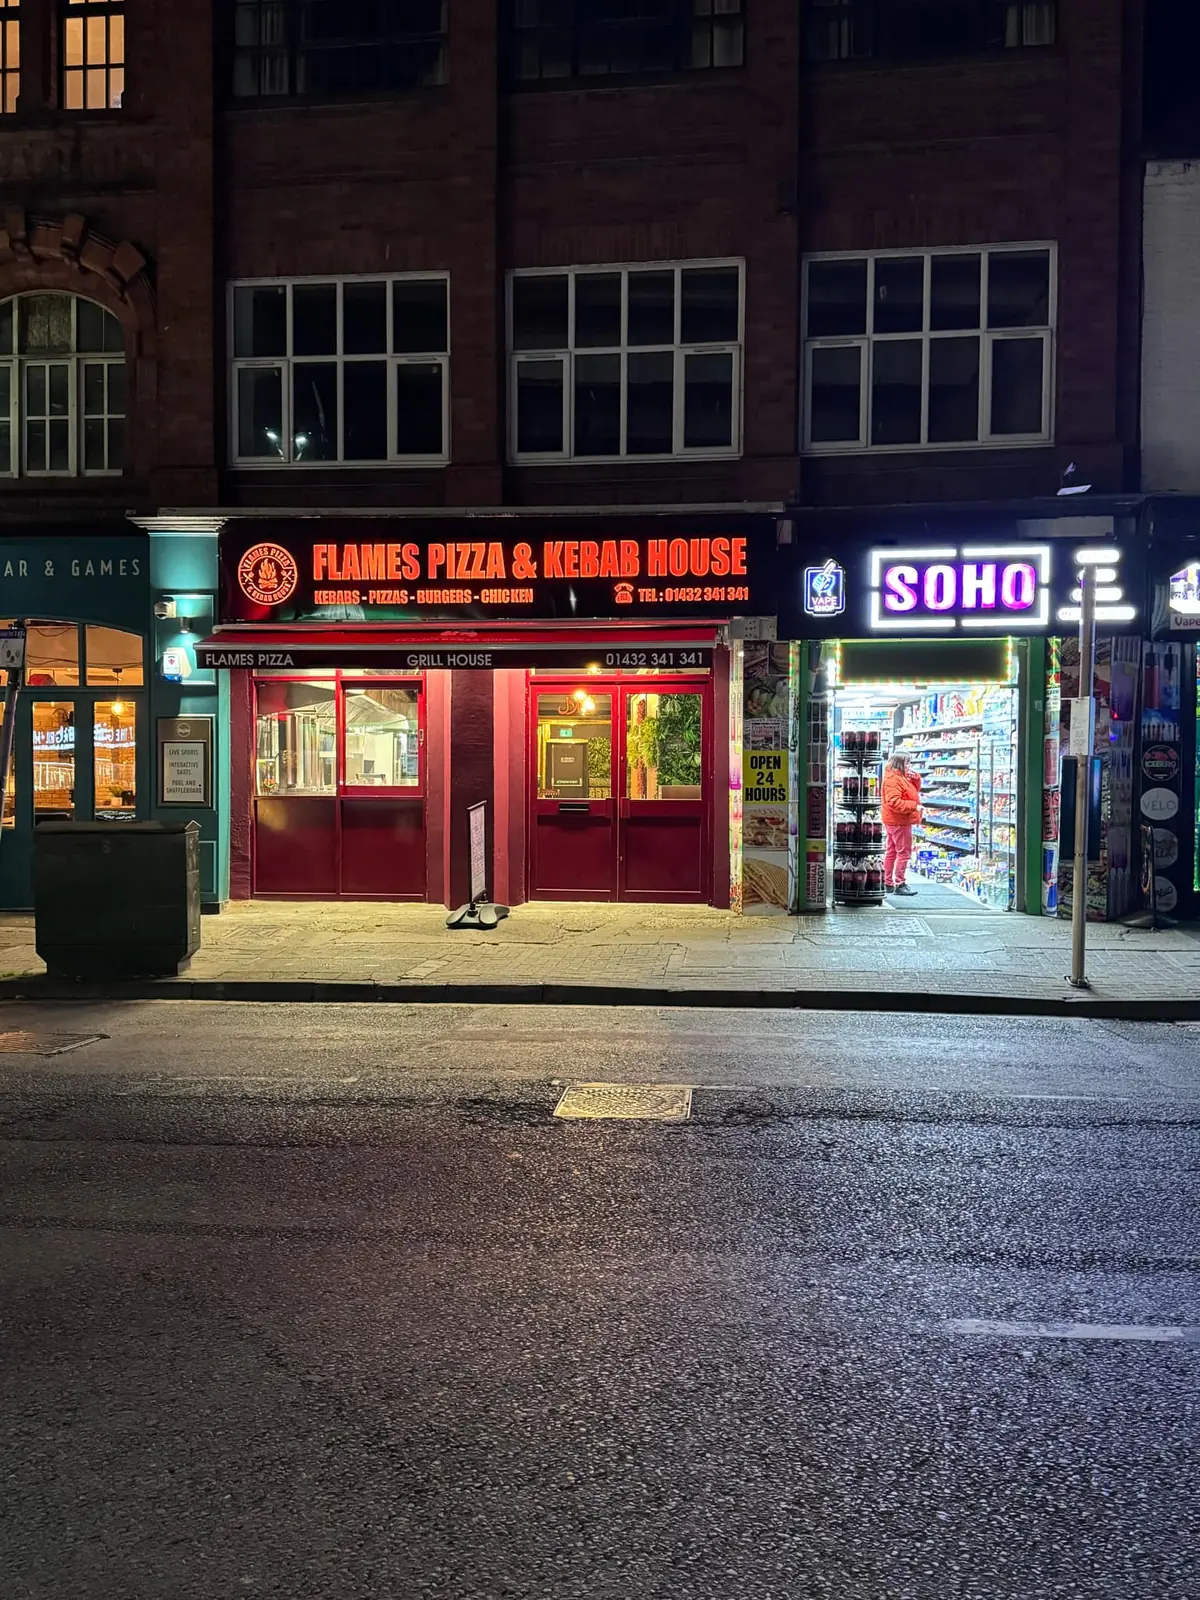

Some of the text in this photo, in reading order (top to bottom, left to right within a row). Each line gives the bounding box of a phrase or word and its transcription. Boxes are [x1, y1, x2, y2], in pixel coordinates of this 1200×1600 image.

[243, 547, 290, 568] FLAMES PIZZA
[313, 537, 747, 581] FLAMES PIZZA & KEBAB HOUSE
[44, 560, 54, 576] &
[71, 559, 140, 576] GAMES
[665, 587, 702, 601] 01432
[703, 587, 725, 601] 341
[727, 587, 749, 600] 341
[884, 563, 1036, 612] SOHO
[314, 590, 360, 604] KEBABS
[368, 590, 408, 604] PIZZAS
[416, 589, 472, 604] BURGERS
[480, 588, 534, 603] CHICKEN
[811, 596, 838, 606] VAPE
[205, 653, 294, 666] FLAMES PIZZA
[406, 653, 492, 667] GRILL HOUSE
[605, 652, 703, 666] 01432 341 341
[750, 756, 781, 770] OPEN
[756, 771, 774, 785] 24
[745, 787, 786, 801] HOURS
[1142, 800, 1177, 812] VELO
[817, 863, 825, 903] ENERGY
